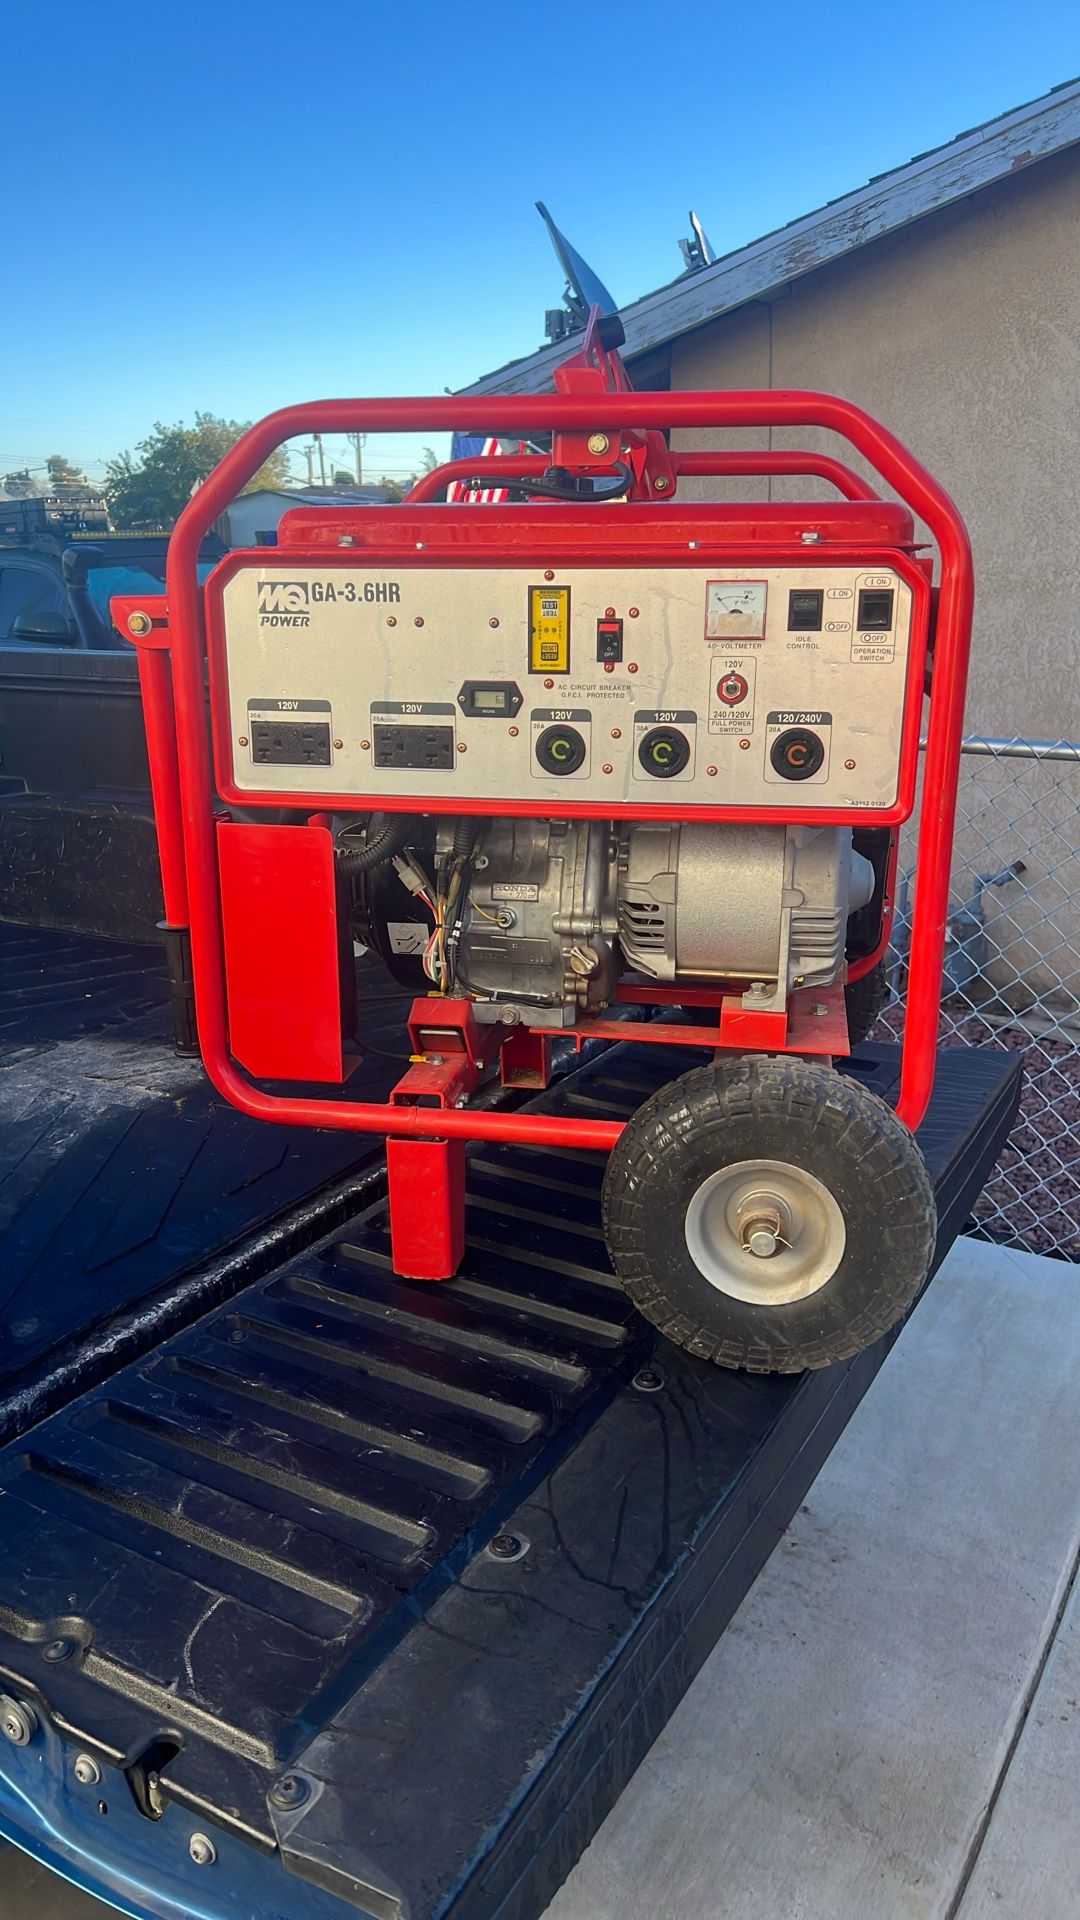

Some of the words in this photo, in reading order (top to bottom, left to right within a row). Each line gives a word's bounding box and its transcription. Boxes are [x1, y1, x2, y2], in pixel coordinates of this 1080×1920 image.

[257, 581, 309, 614] MQ
[311, 582, 400, 602] GA-3.6HR
[542, 601, 558, 609] TEST
[260, 616, 310, 627] POWER
[277, 701, 299, 710] 120V
[401, 704, 423, 713] 120V
[549, 711, 573, 720] 120V
[654, 712, 677, 721] 120V
[777, 713, 822, 723] 120/240V
